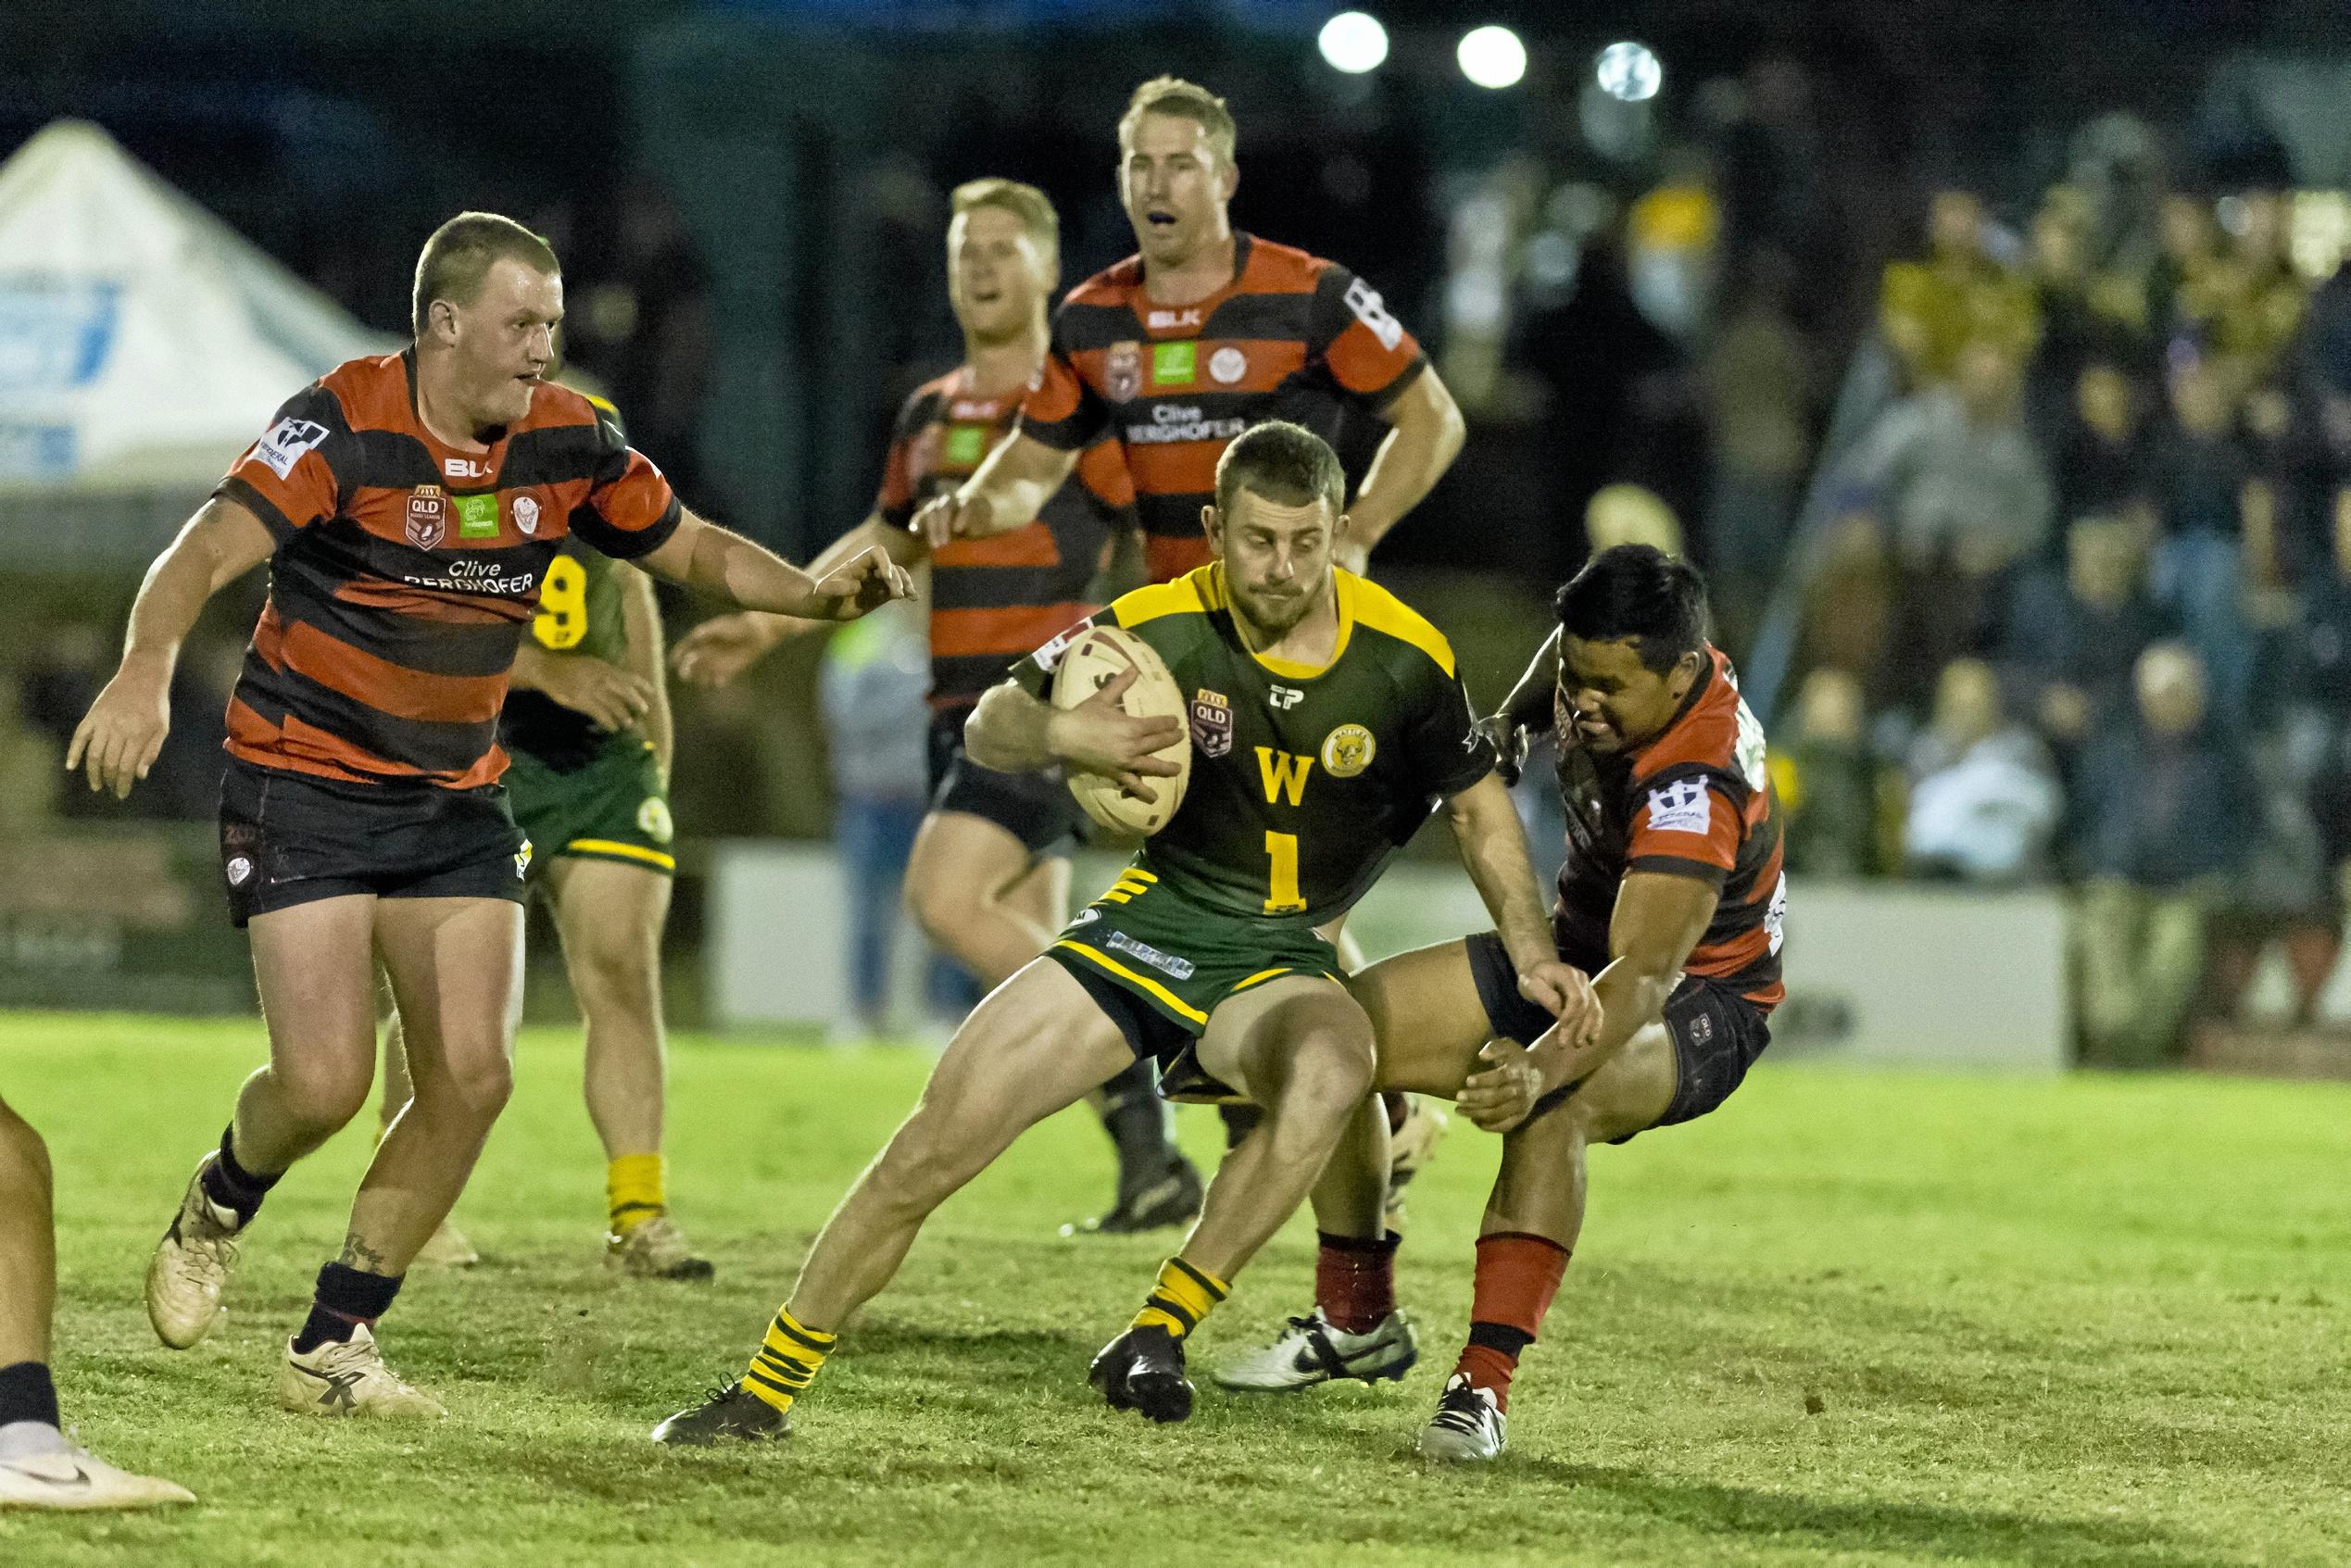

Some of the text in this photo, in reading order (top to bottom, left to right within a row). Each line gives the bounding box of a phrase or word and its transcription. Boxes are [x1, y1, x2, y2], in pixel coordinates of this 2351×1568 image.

[411, 500, 439, 514] QLD
[448, 560, 502, 577] Clive
[533, 555, 588, 650] 9
[1197, 706, 1226, 723] QLD
[1253, 746, 1315, 807] W
[1263, 830, 1307, 914] 1
